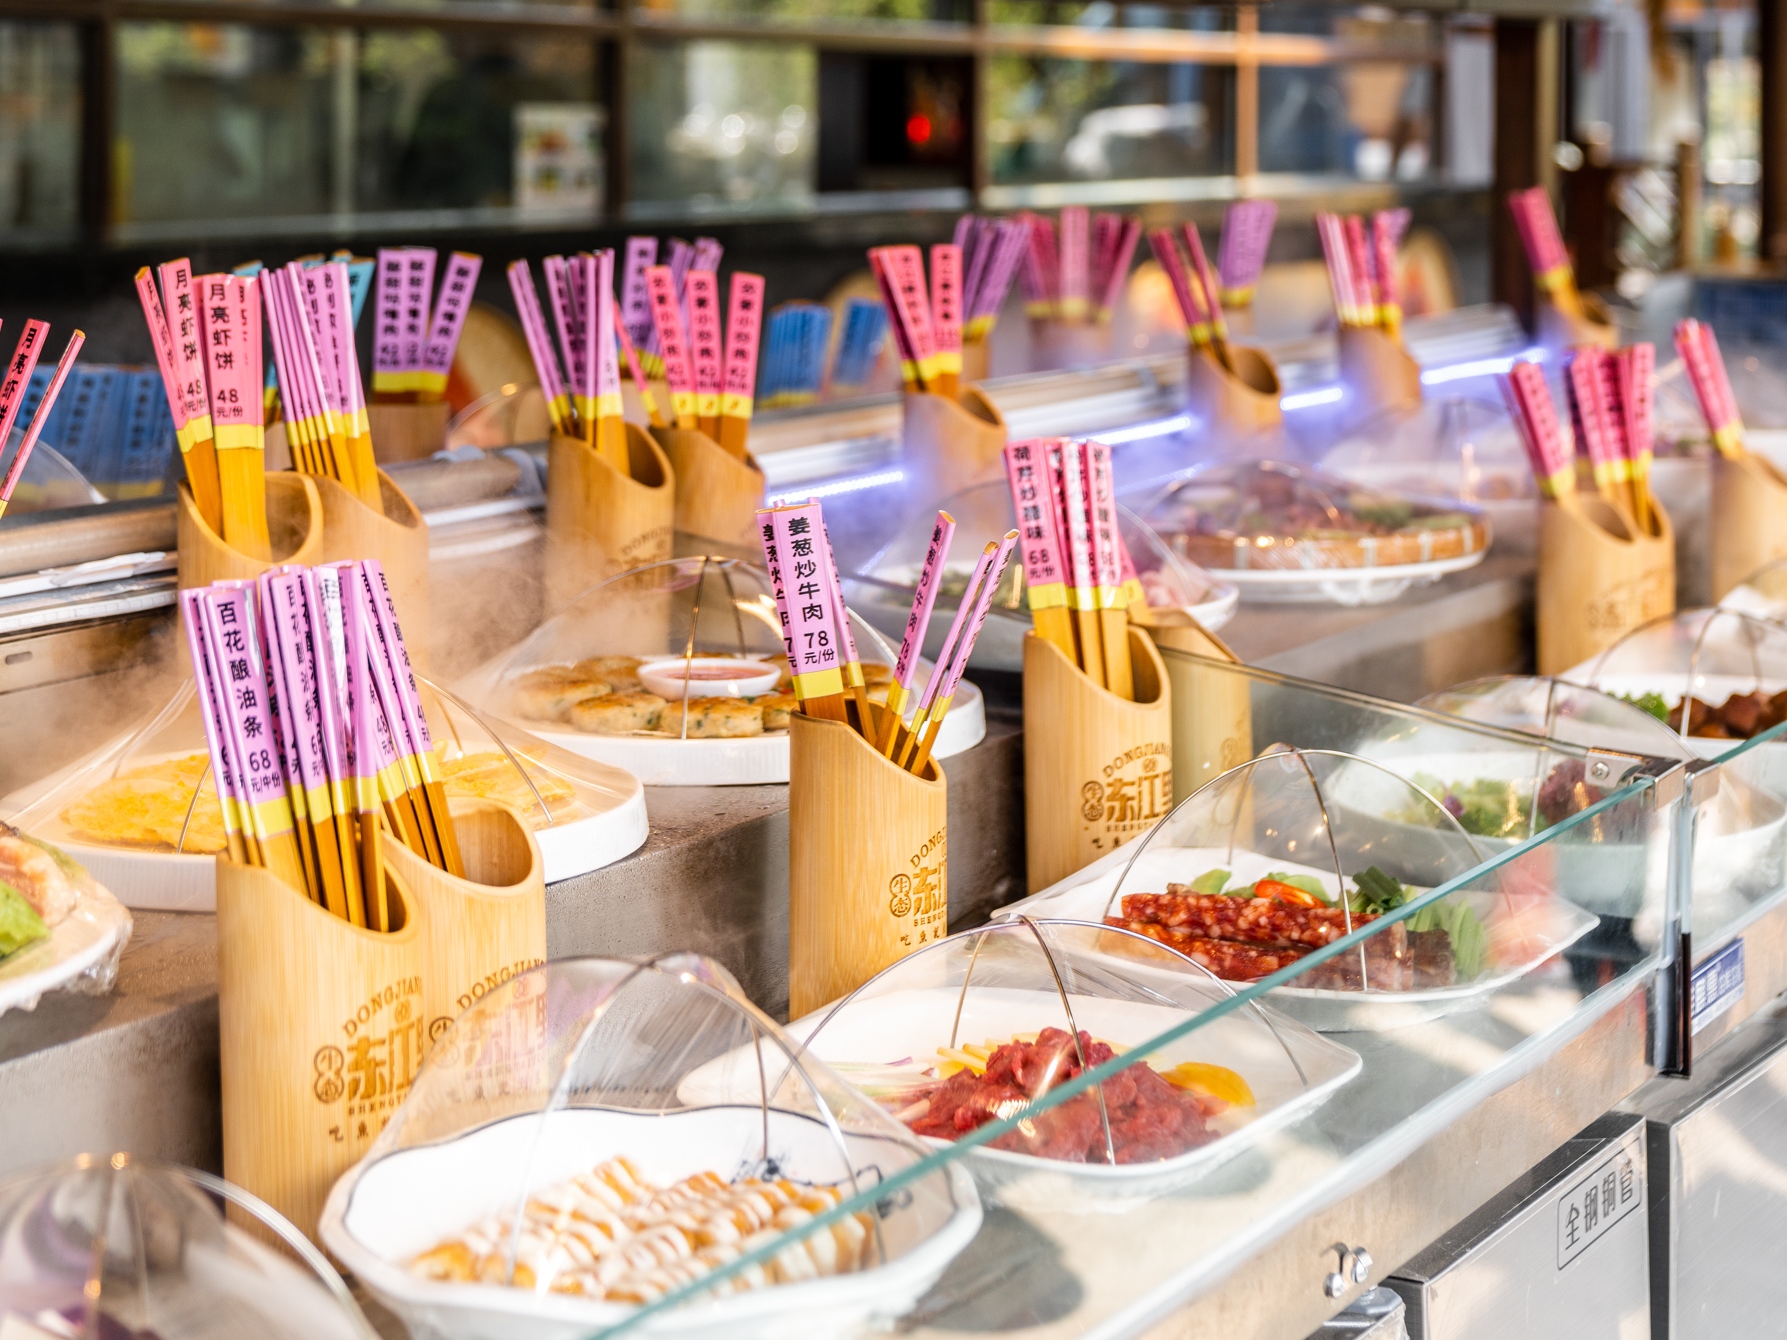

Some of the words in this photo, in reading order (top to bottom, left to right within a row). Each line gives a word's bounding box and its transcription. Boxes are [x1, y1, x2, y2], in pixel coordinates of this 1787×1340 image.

[176, 269, 198, 362] 月亮虾饼
[210, 284, 233, 370] 月亮虾饼
[217, 388, 238, 403] 48
[216, 407, 243, 419] 元/份
[1029, 550, 1049, 564] 68
[788, 516, 823, 623] 姜葱炒牛肉
[804, 630, 829, 649] 78
[804, 647, 834, 665] 元/份
[217, 601, 263, 739] 百花酿油条
[249, 749, 271, 772] 68
[250, 771, 281, 793] 元/中份
